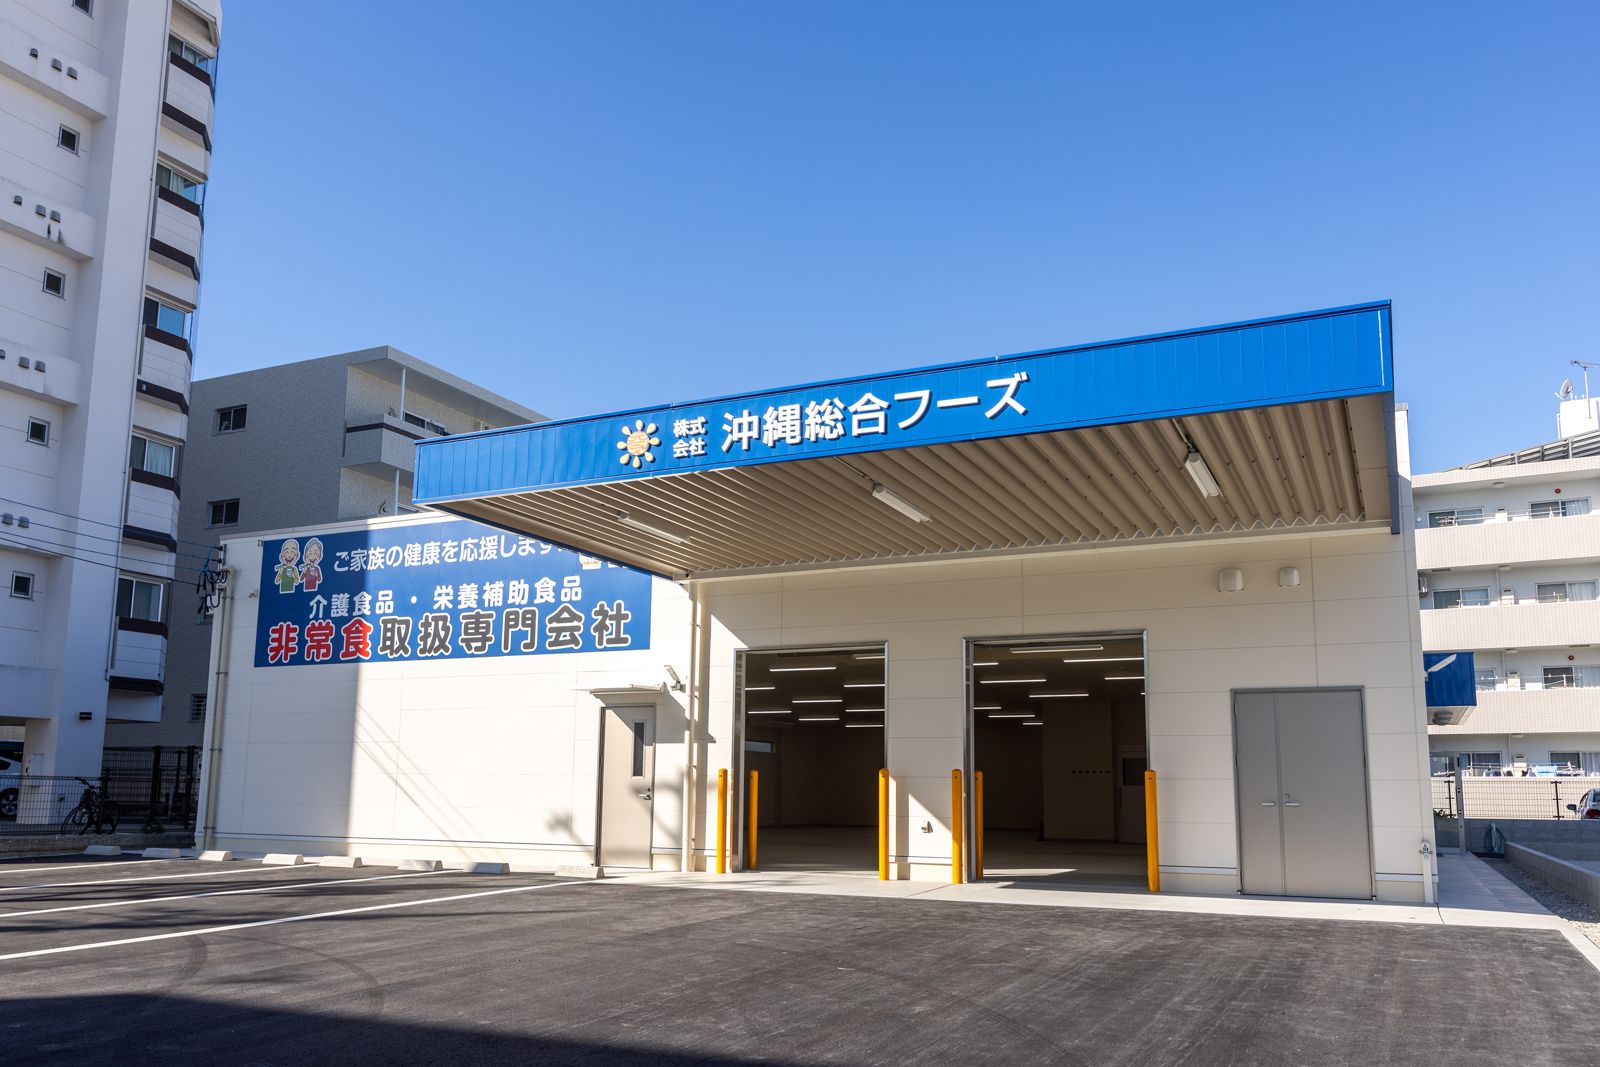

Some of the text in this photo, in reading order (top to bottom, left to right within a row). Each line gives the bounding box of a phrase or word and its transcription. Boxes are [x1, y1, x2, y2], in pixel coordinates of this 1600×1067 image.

[673, 416, 707, 437] 株式
[721, 371, 1028, 452] 沖縄総合フーズ
[673, 437, 706, 458] 会社
[333, 534, 563, 573] ご家族の健康を応援しま
[267, 600, 632, 664] 非常食取扱専門会社
